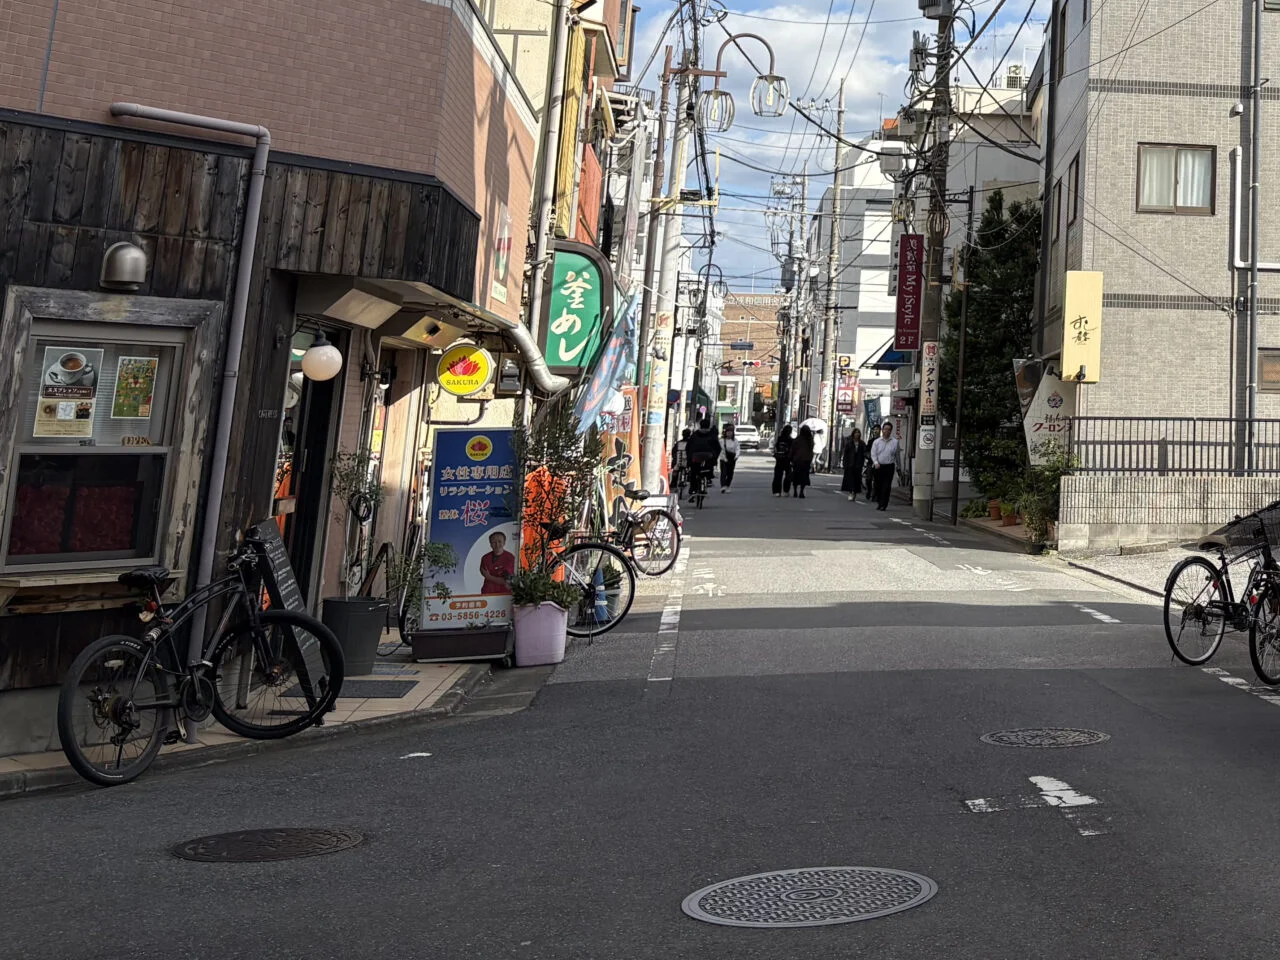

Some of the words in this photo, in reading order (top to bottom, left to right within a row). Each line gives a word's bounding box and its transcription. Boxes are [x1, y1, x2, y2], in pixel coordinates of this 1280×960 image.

[551, 271, 597, 362] 釜めし
[461, 499, 490, 527] 桜
